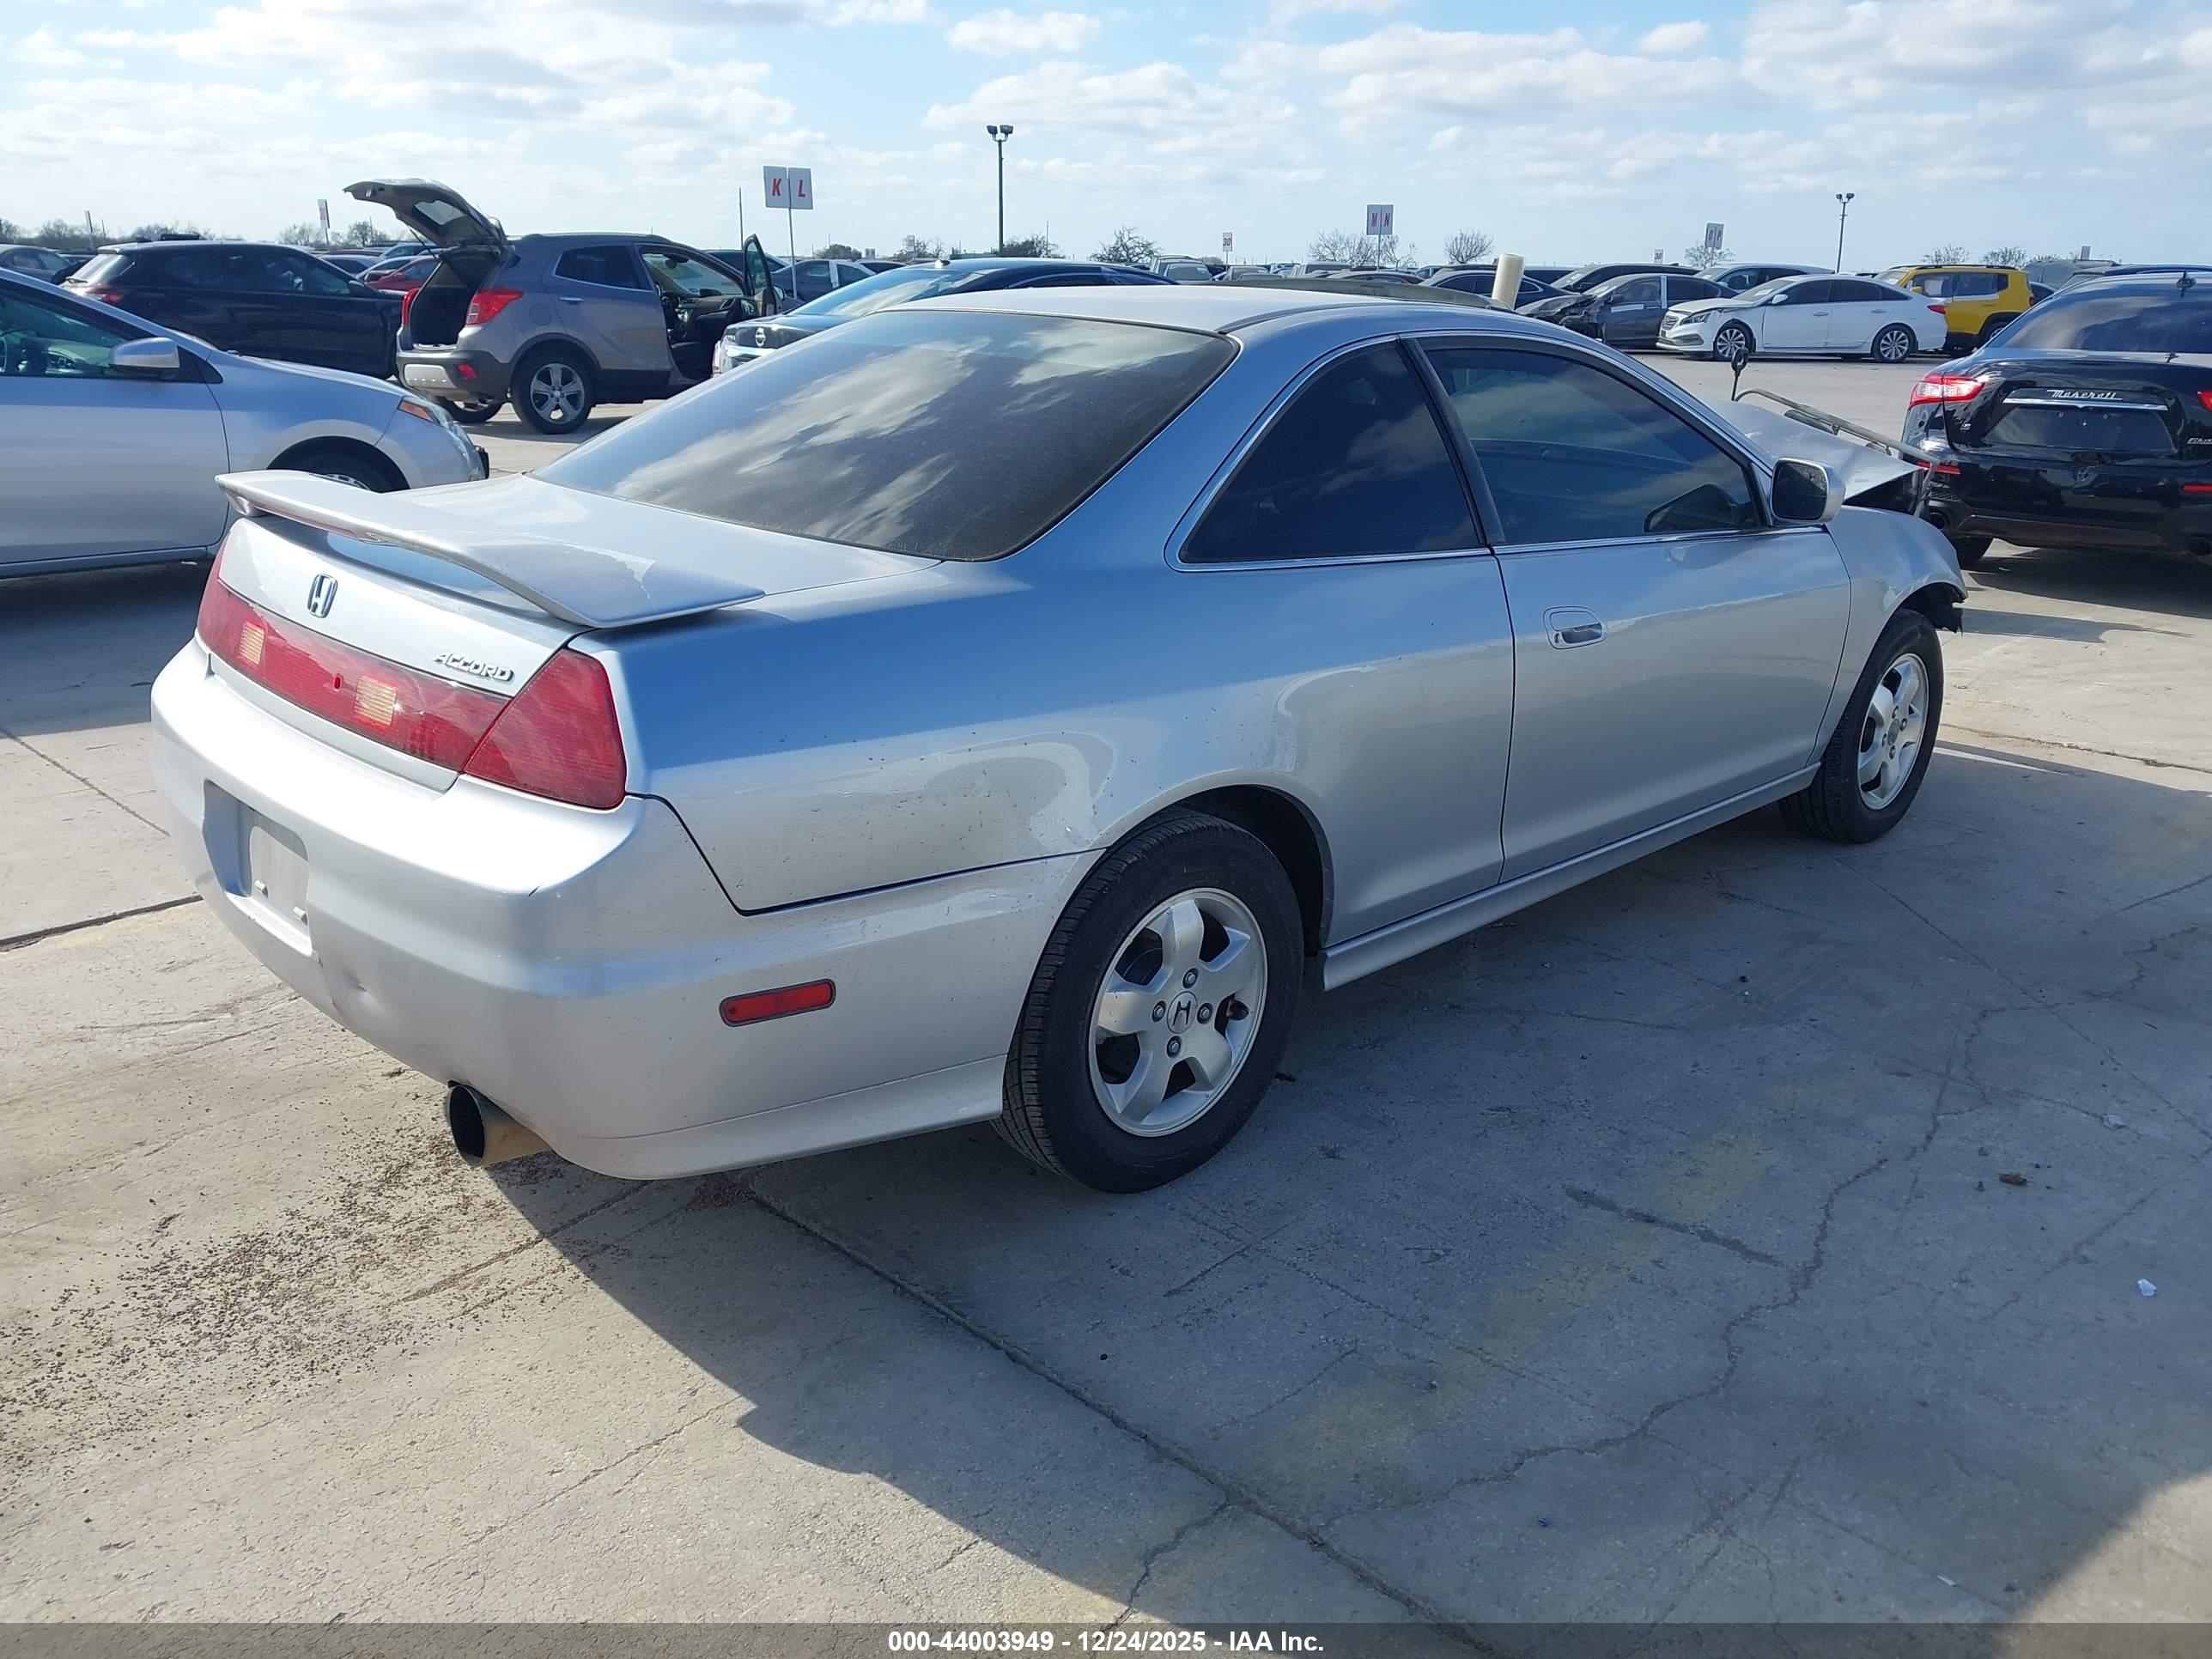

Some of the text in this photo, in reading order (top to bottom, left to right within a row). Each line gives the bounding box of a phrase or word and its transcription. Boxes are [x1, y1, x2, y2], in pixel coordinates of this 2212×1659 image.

[772, 178, 805, 198] K L
[1371, 212, 1390, 227] M N
[1223, 237, 1231, 246] 30
[2046, 389, 2123, 401] Maserati
[433, 652, 515, 682] ACCORD
